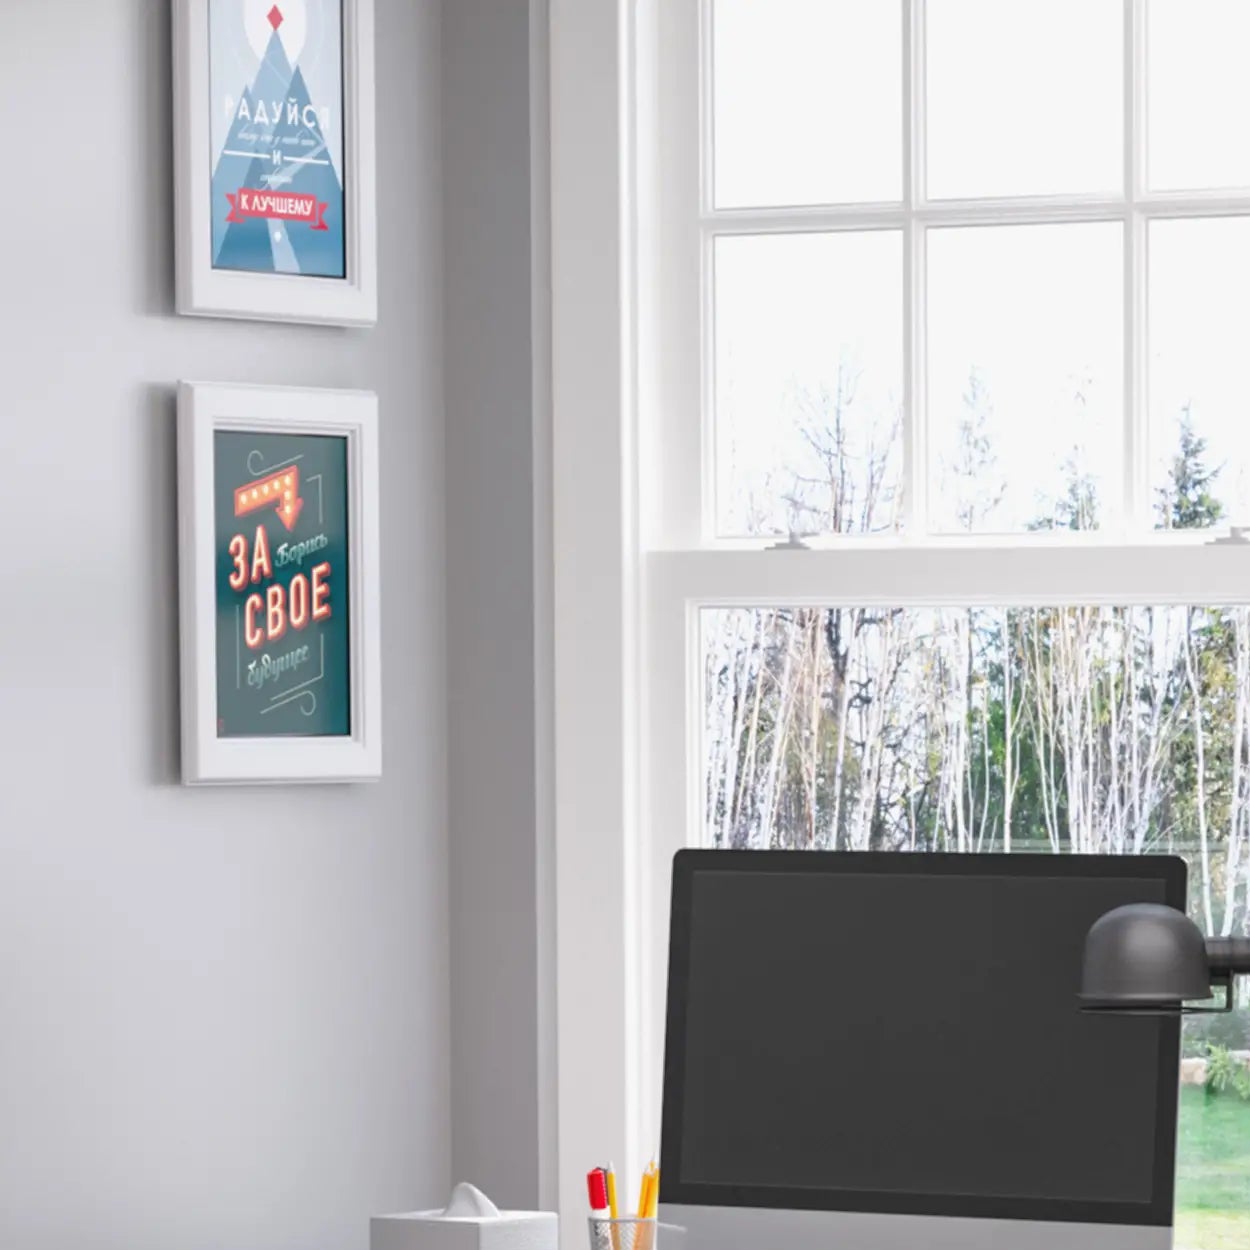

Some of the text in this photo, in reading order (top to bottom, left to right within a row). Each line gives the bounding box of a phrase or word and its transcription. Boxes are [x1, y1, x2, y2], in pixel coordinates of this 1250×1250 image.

[241, 194, 313, 216] К ЛУЧШЕМУ
[228, 525, 272, 591] ЗА
[243, 561, 331, 649] СВОЕ
